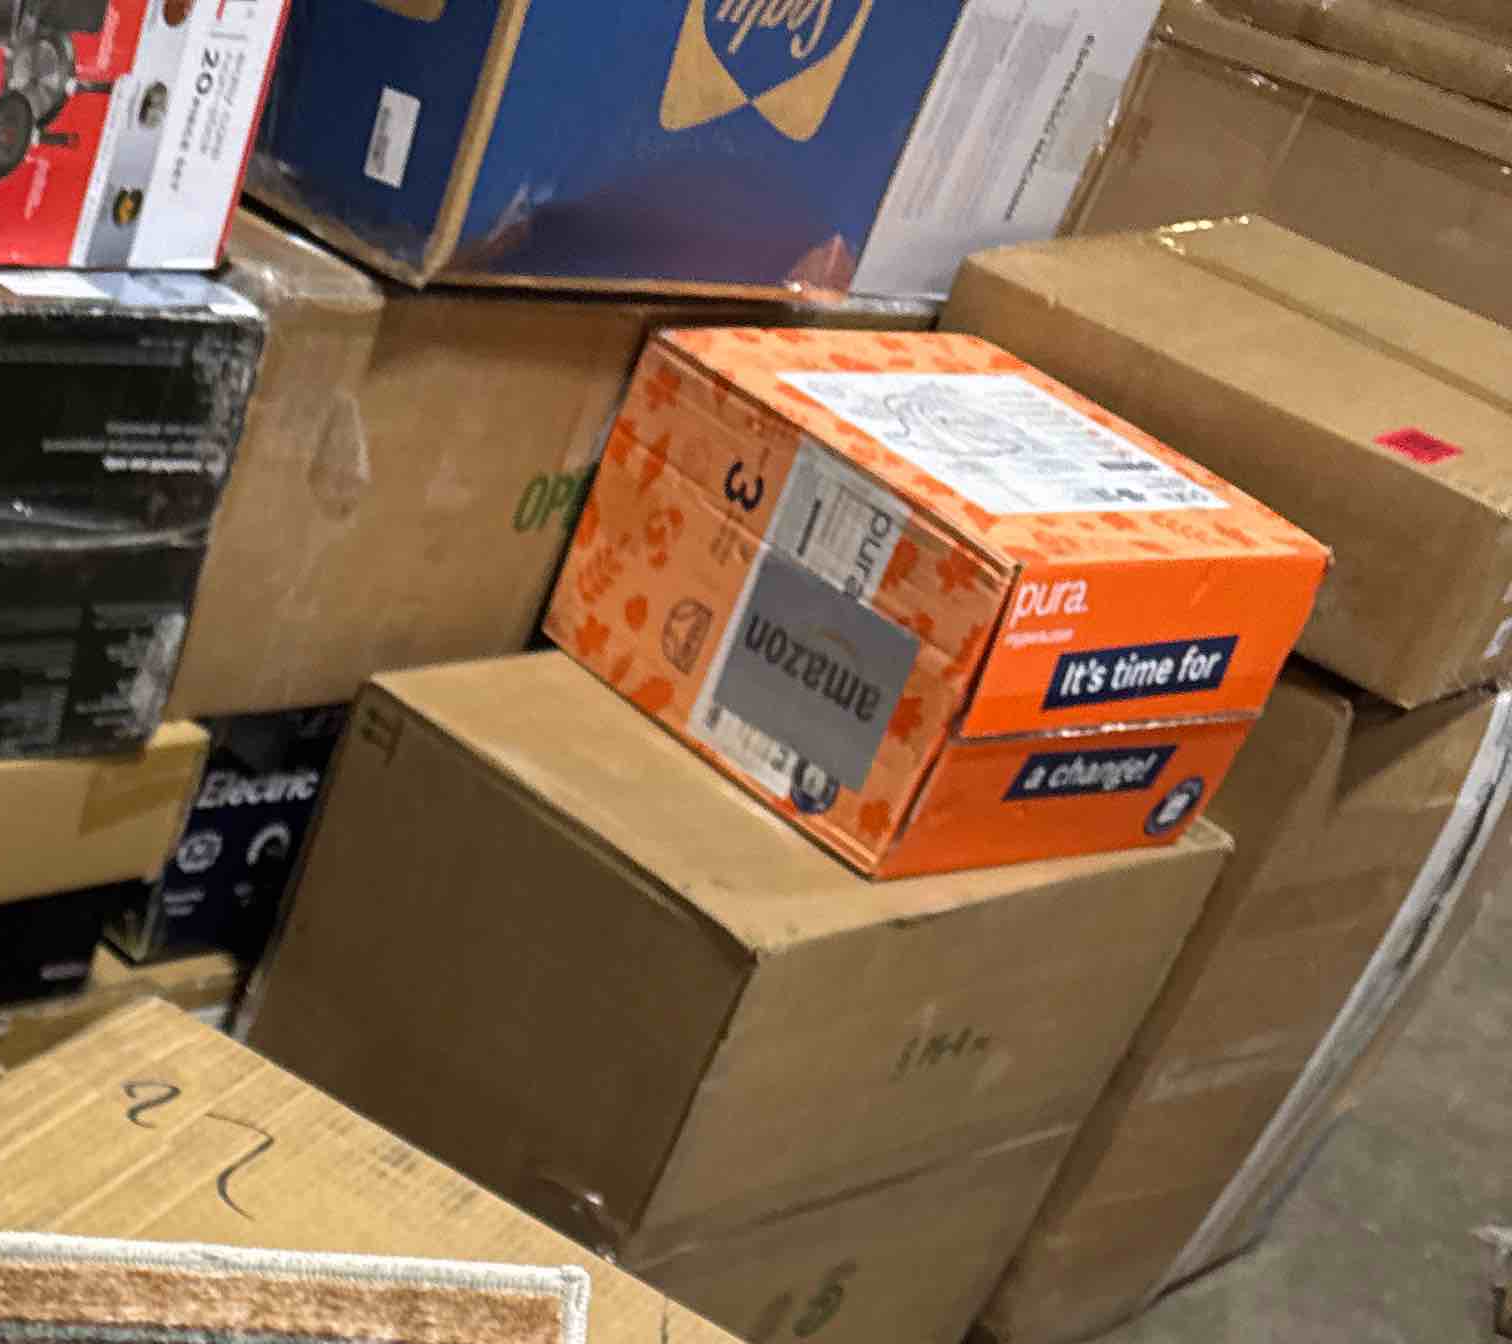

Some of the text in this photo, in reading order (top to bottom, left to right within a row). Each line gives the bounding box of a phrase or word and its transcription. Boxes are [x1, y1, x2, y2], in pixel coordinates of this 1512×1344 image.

[745, 615, 882, 723] amazon
[1059, 643, 1223, 697] It's time for
